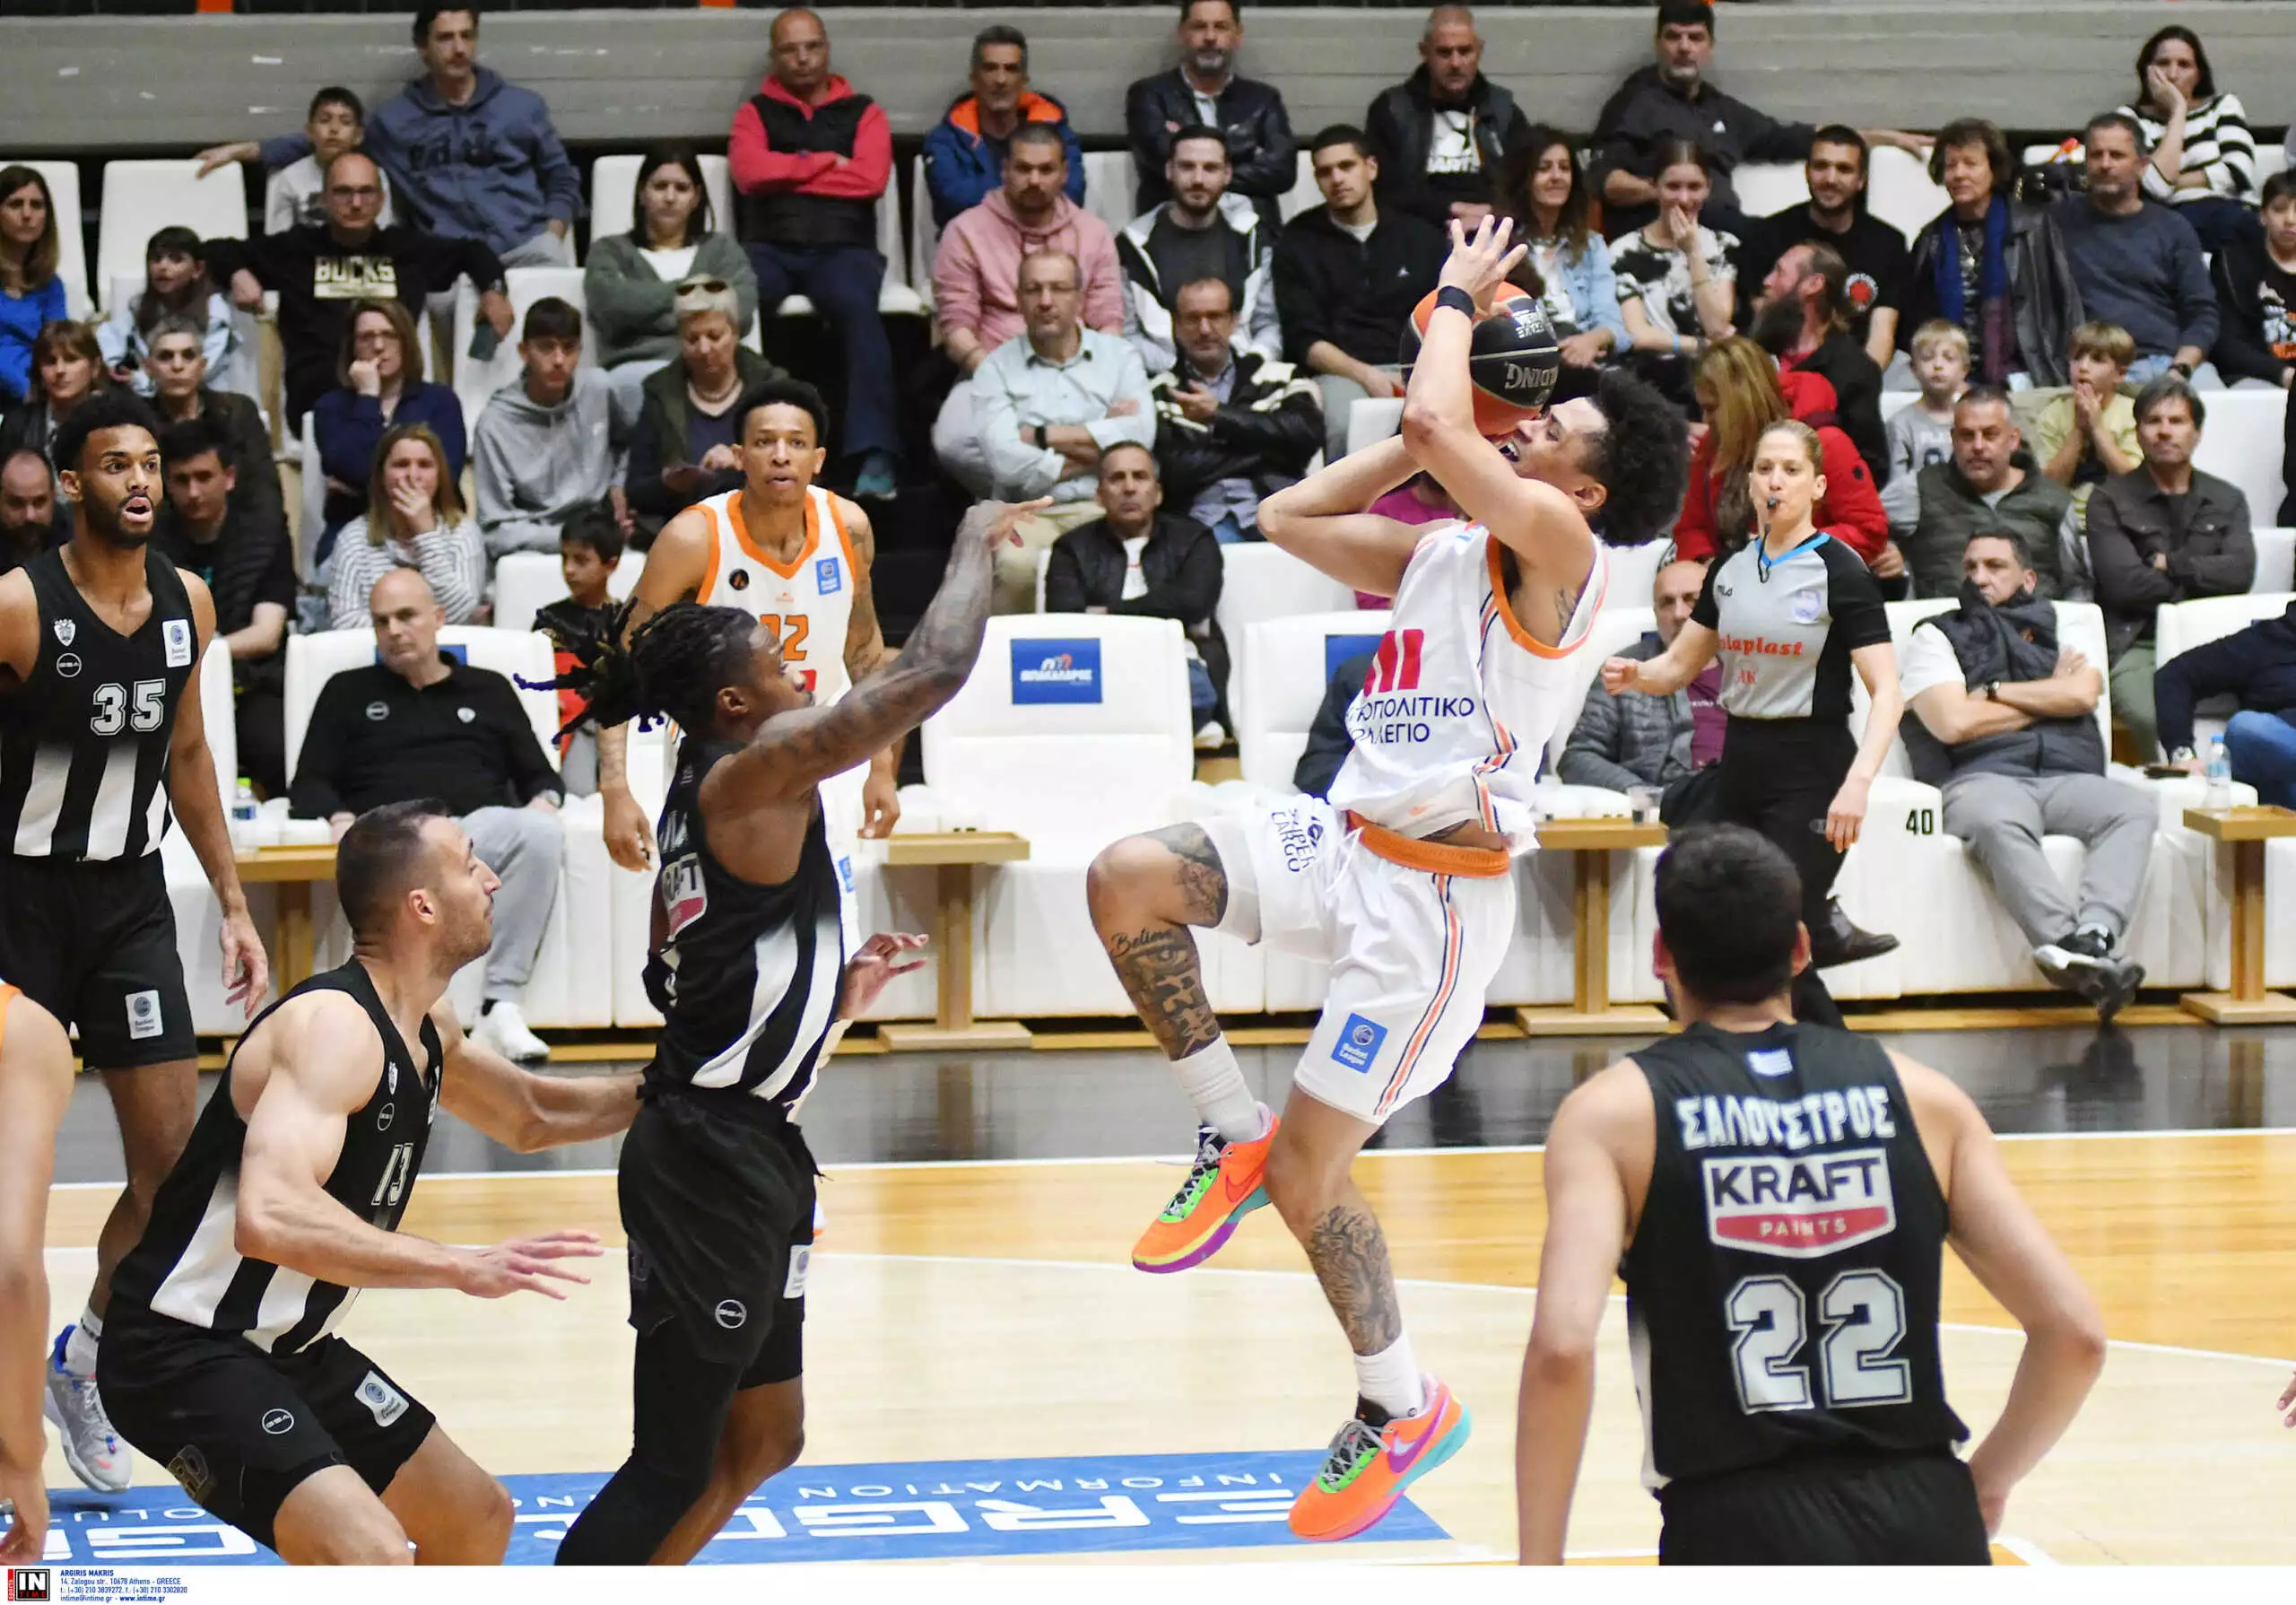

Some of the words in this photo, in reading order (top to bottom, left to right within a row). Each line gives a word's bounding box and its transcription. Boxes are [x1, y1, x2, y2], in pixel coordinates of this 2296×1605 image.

[315, 257, 396, 284] BUCKS
[91, 678, 166, 736] 35
[1906, 808, 1933, 835] 40
[370, 1142, 414, 1207] 13
[1711, 1157, 1880, 1207] KRAFT
[1760, 1217, 1847, 1236] PAINTS
[1725, 1268, 1913, 1416] 22
[798, 1471, 1283, 1500] INFORMATION
